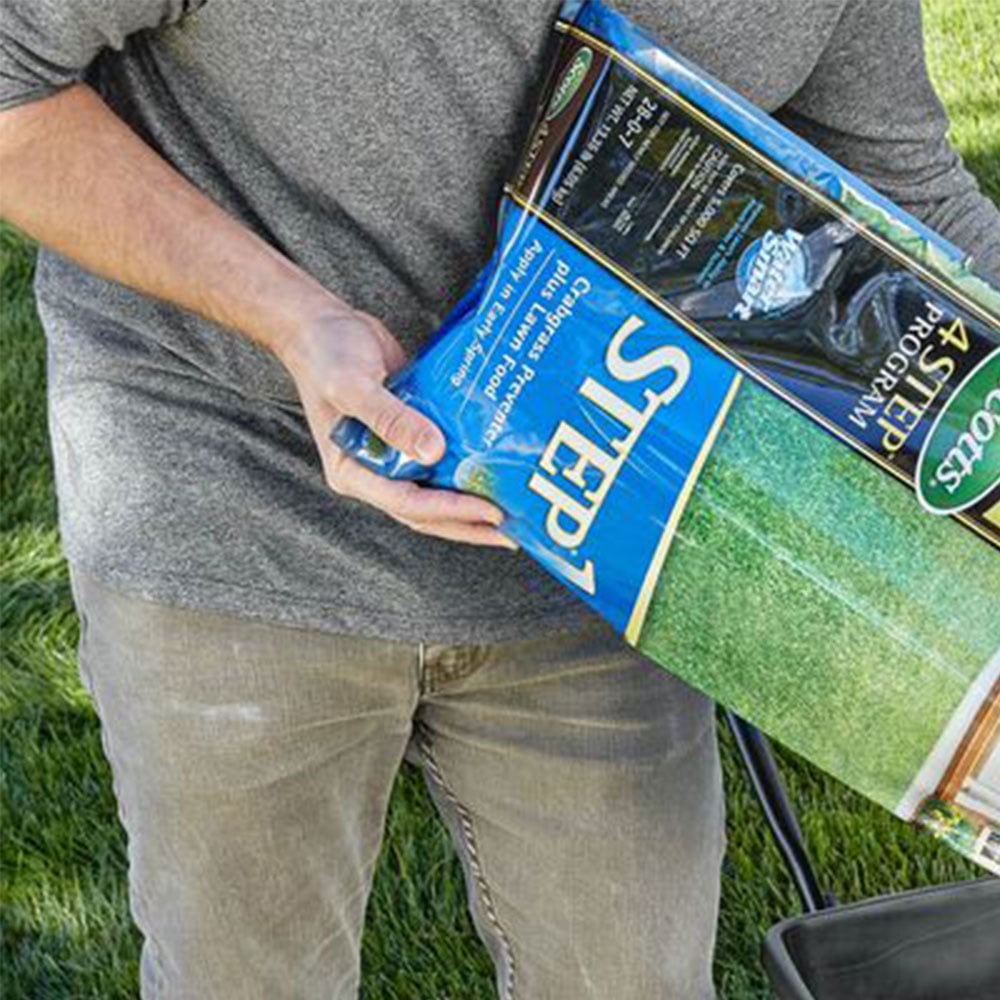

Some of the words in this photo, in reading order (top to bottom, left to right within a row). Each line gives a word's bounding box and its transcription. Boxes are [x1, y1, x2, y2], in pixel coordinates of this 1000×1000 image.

[615, 96, 658, 149] 28-0-7
[714, 162, 745, 197] Covers
[507, 238, 544, 283] Apply
[538, 258, 572, 302] plus
[498, 282, 516, 301] in
[472, 300, 506, 343] Early
[508, 302, 546, 352] Lawn
[526, 275, 591, 363] Crabgrass
[938, 318, 969, 353] 4
[447, 338, 484, 388] Spring
[481, 354, 515, 402] Food
[847, 300, 943, 428] PROGRAM
[479, 364, 534, 447] Preventer
[875, 344, 956, 451] STEP
[527, 313, 691, 554] STEP
[536, 538, 594, 594] 1
